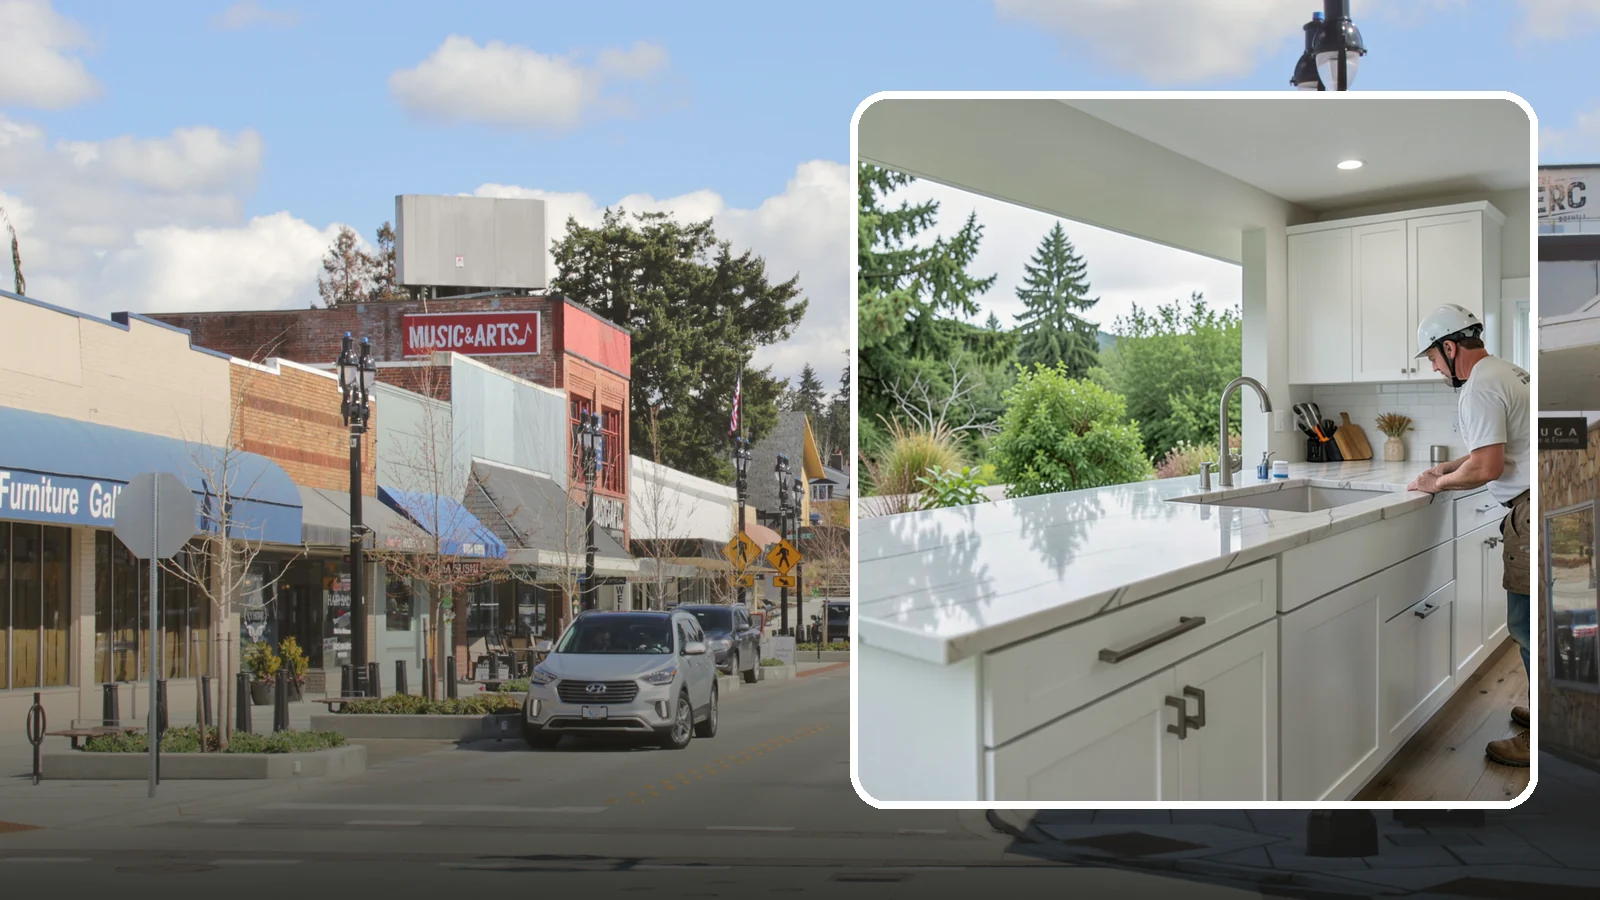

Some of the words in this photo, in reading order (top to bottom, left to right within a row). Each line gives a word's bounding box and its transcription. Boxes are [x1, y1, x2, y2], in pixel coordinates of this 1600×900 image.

[408, 323, 519, 349] MUSIC&ARTS
[0, 471, 79, 515] Furniture
[454, 563, 479, 573] SUSHI
